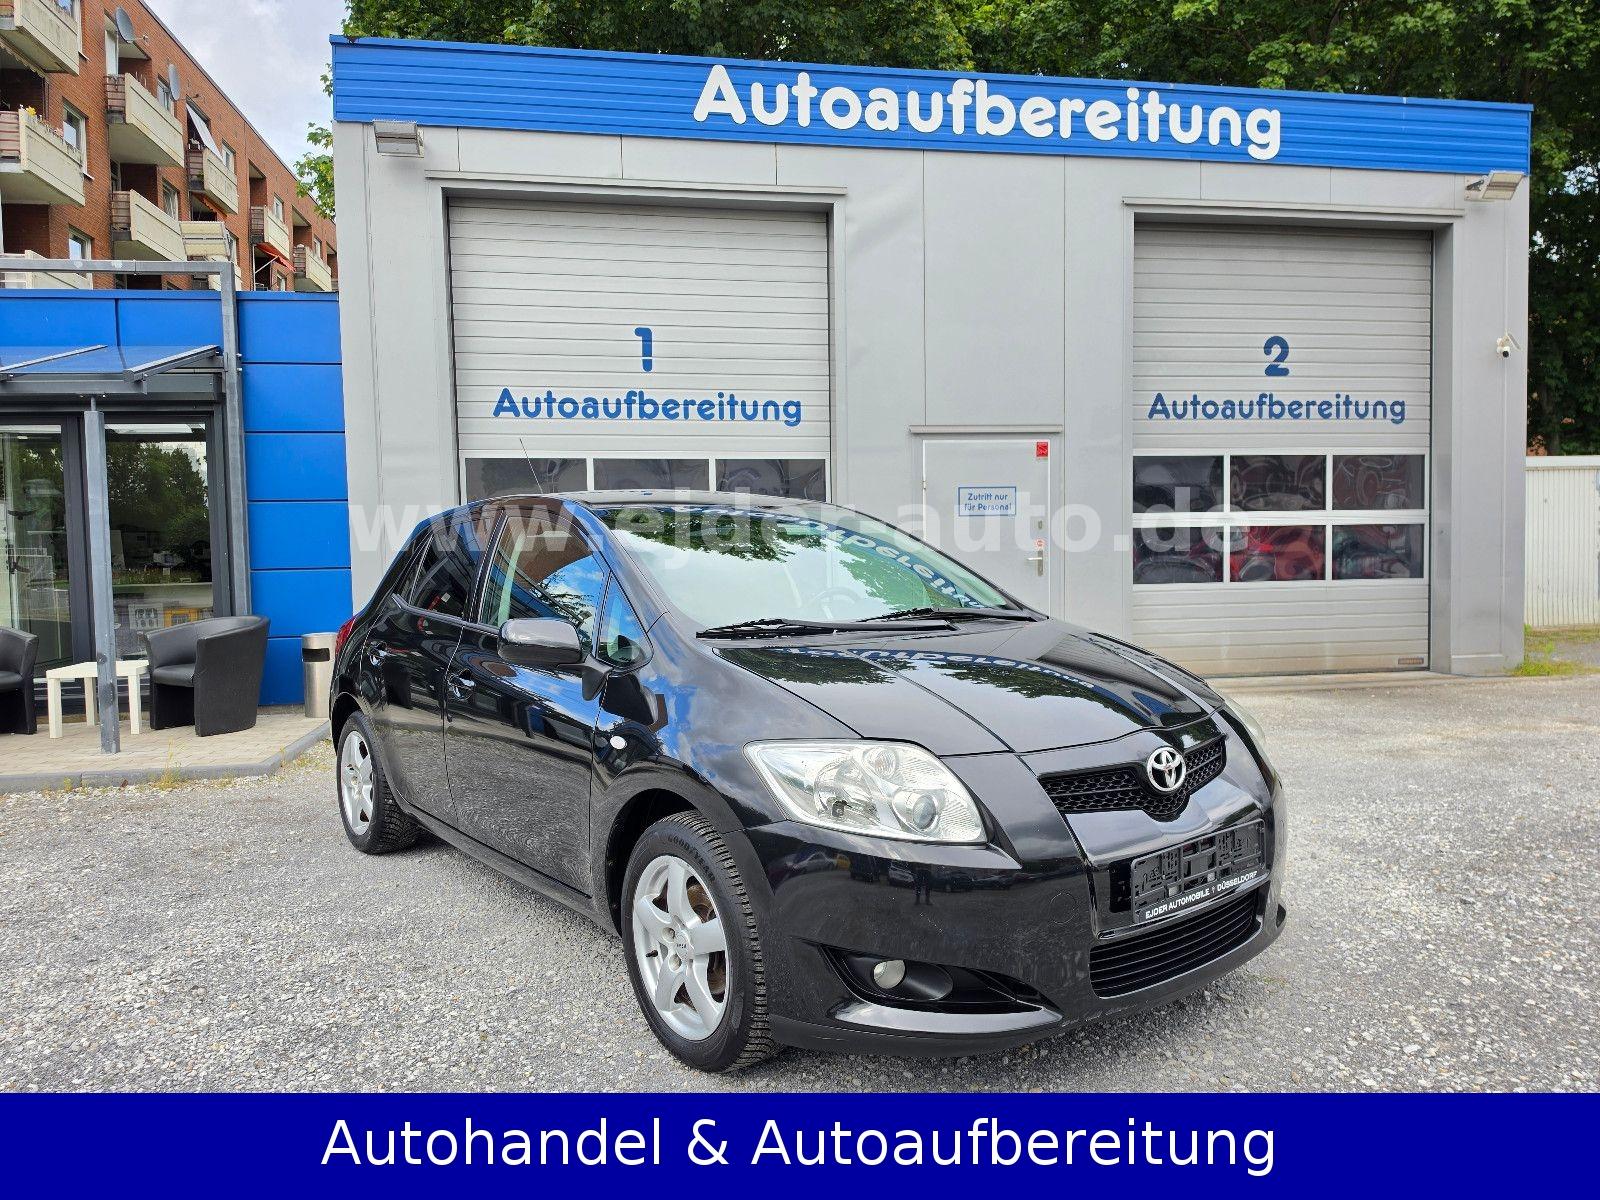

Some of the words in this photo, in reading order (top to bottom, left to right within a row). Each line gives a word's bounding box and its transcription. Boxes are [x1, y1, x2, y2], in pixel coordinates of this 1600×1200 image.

[693, 64, 1281, 161] Autoaufbereitung
[633, 327, 653, 373] 1
[1263, 336, 1290, 377] 2
[493, 389, 803, 427] Autoaufbereitung
[1148, 393, 1406, 424] Autoaufbereitung
[964, 503, 976, 511] für
[977, 502, 1012, 511] Personal
[967, 492, 993, 501] Zutritt
[1145, 904, 1168, 919] EJDER
[1168, 888, 1211, 910] AUTOMOBILE
[1216, 871, 1258, 892] DÜSSELDORF
